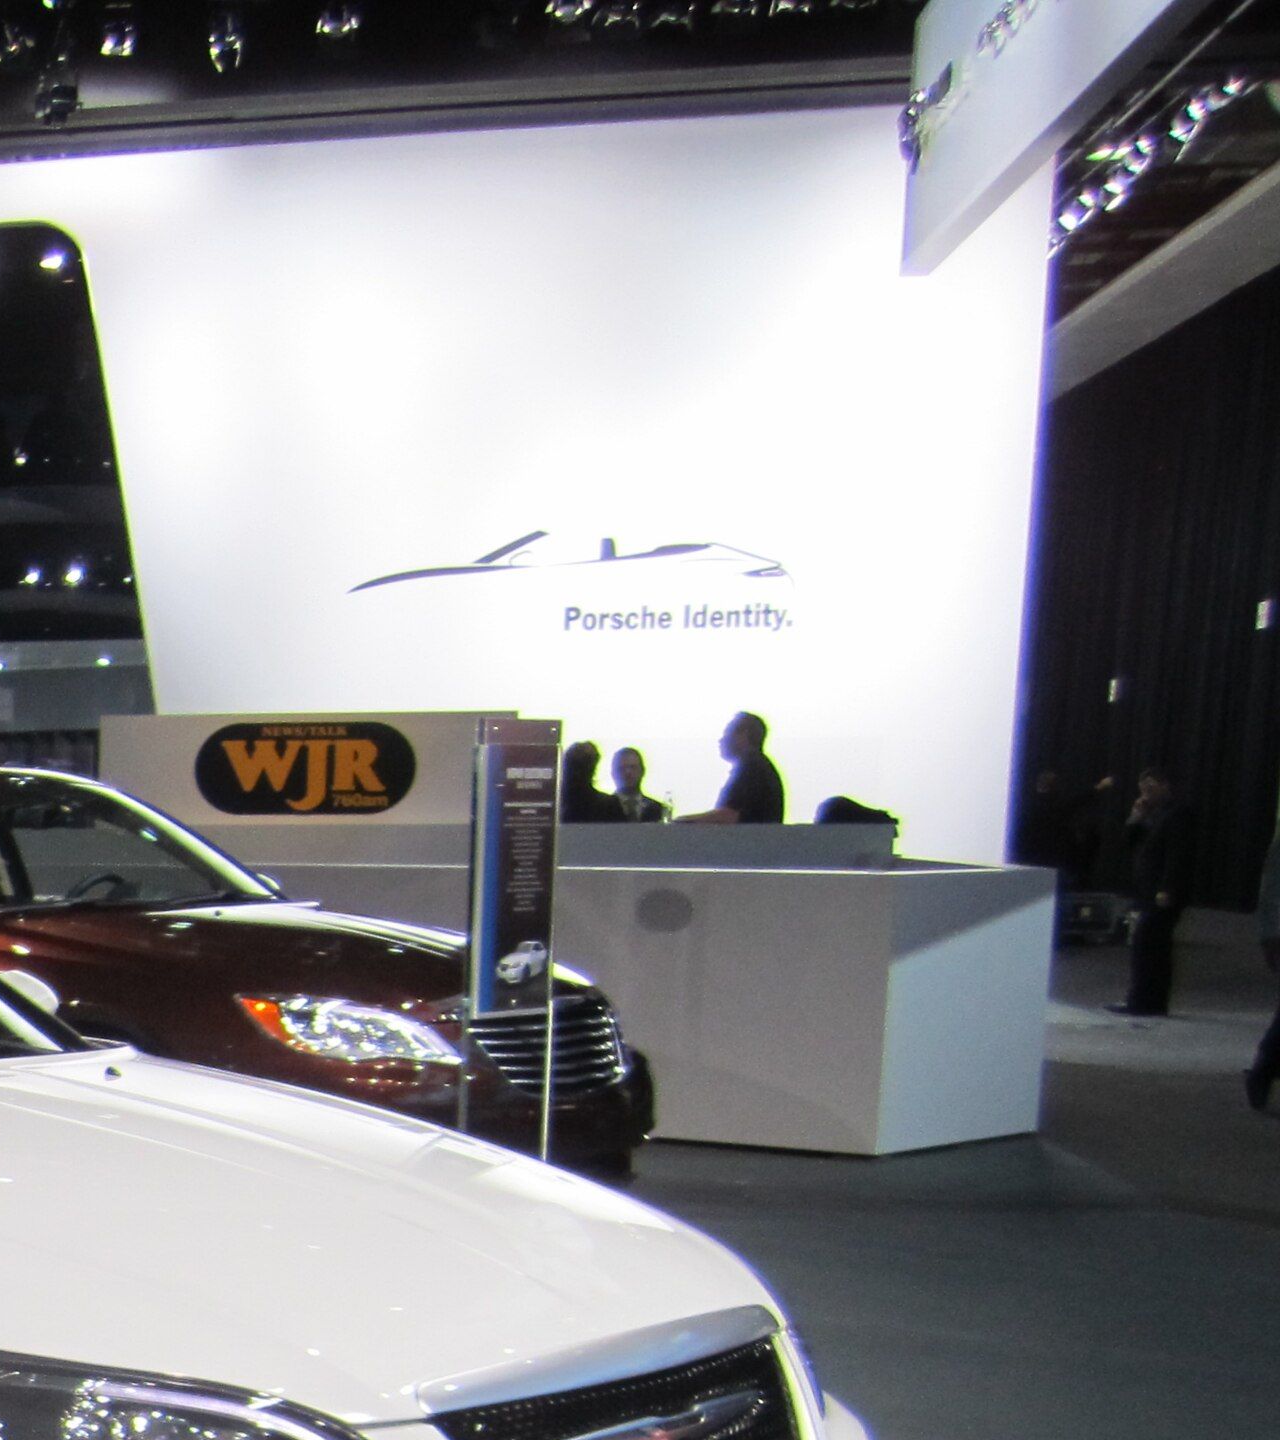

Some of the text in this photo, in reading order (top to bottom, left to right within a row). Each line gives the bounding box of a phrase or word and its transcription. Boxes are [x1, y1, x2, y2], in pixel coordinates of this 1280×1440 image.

[563, 603, 793, 632] Porsche Identity.
[221, 739, 387, 811] WJR
